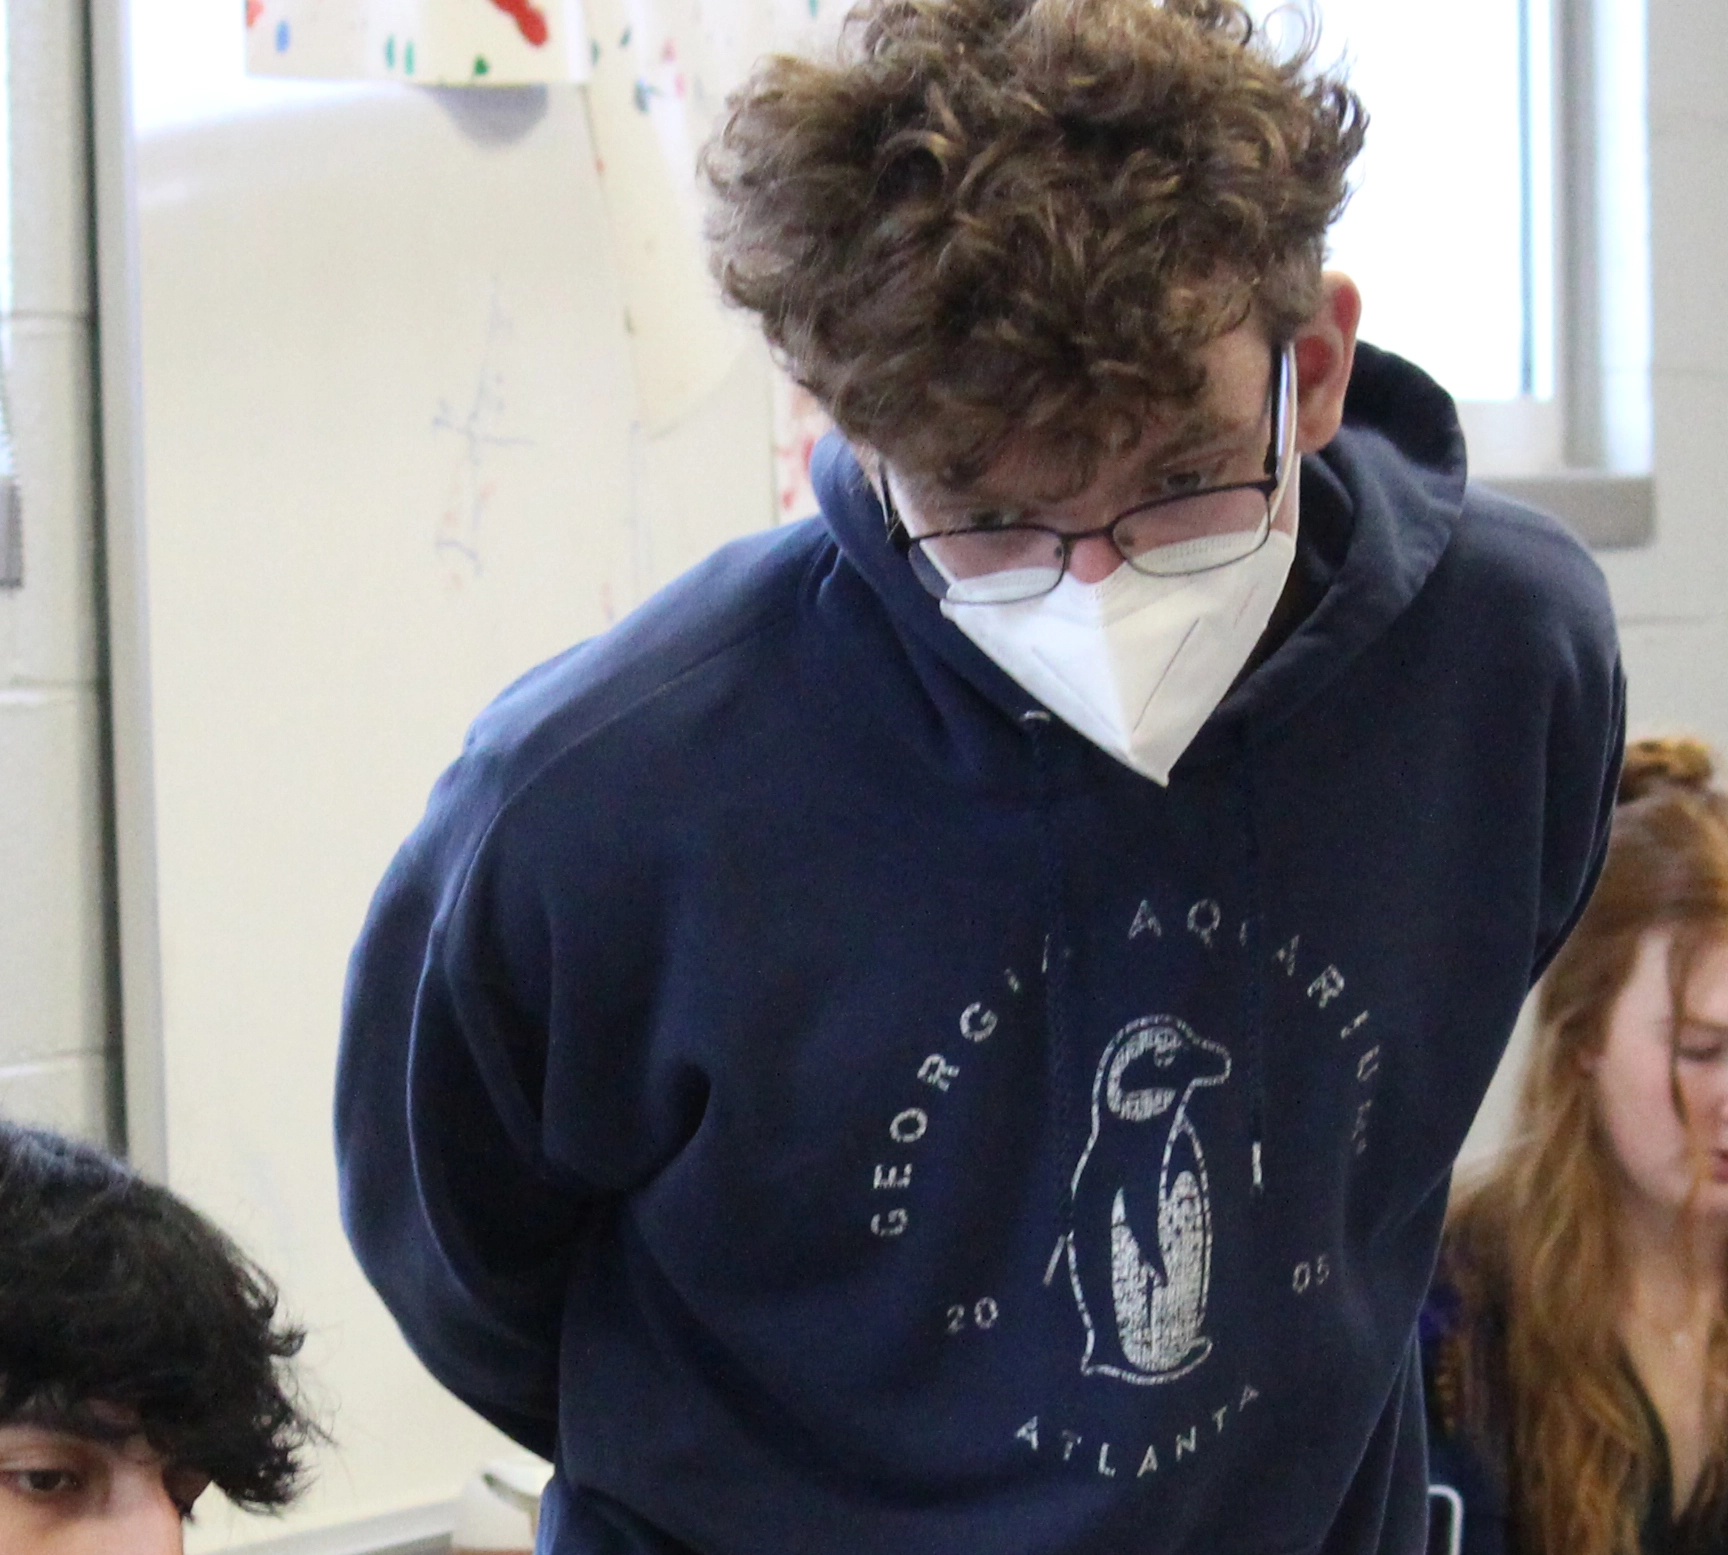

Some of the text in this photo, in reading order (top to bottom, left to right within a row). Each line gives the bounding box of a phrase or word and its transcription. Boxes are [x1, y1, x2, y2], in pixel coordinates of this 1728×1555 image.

[1127, 898, 1381, 1156] AQARIU
[946, 1253, 1331, 1334] 20 05
[1014, 1383, 1260, 1479] ATLANTA
